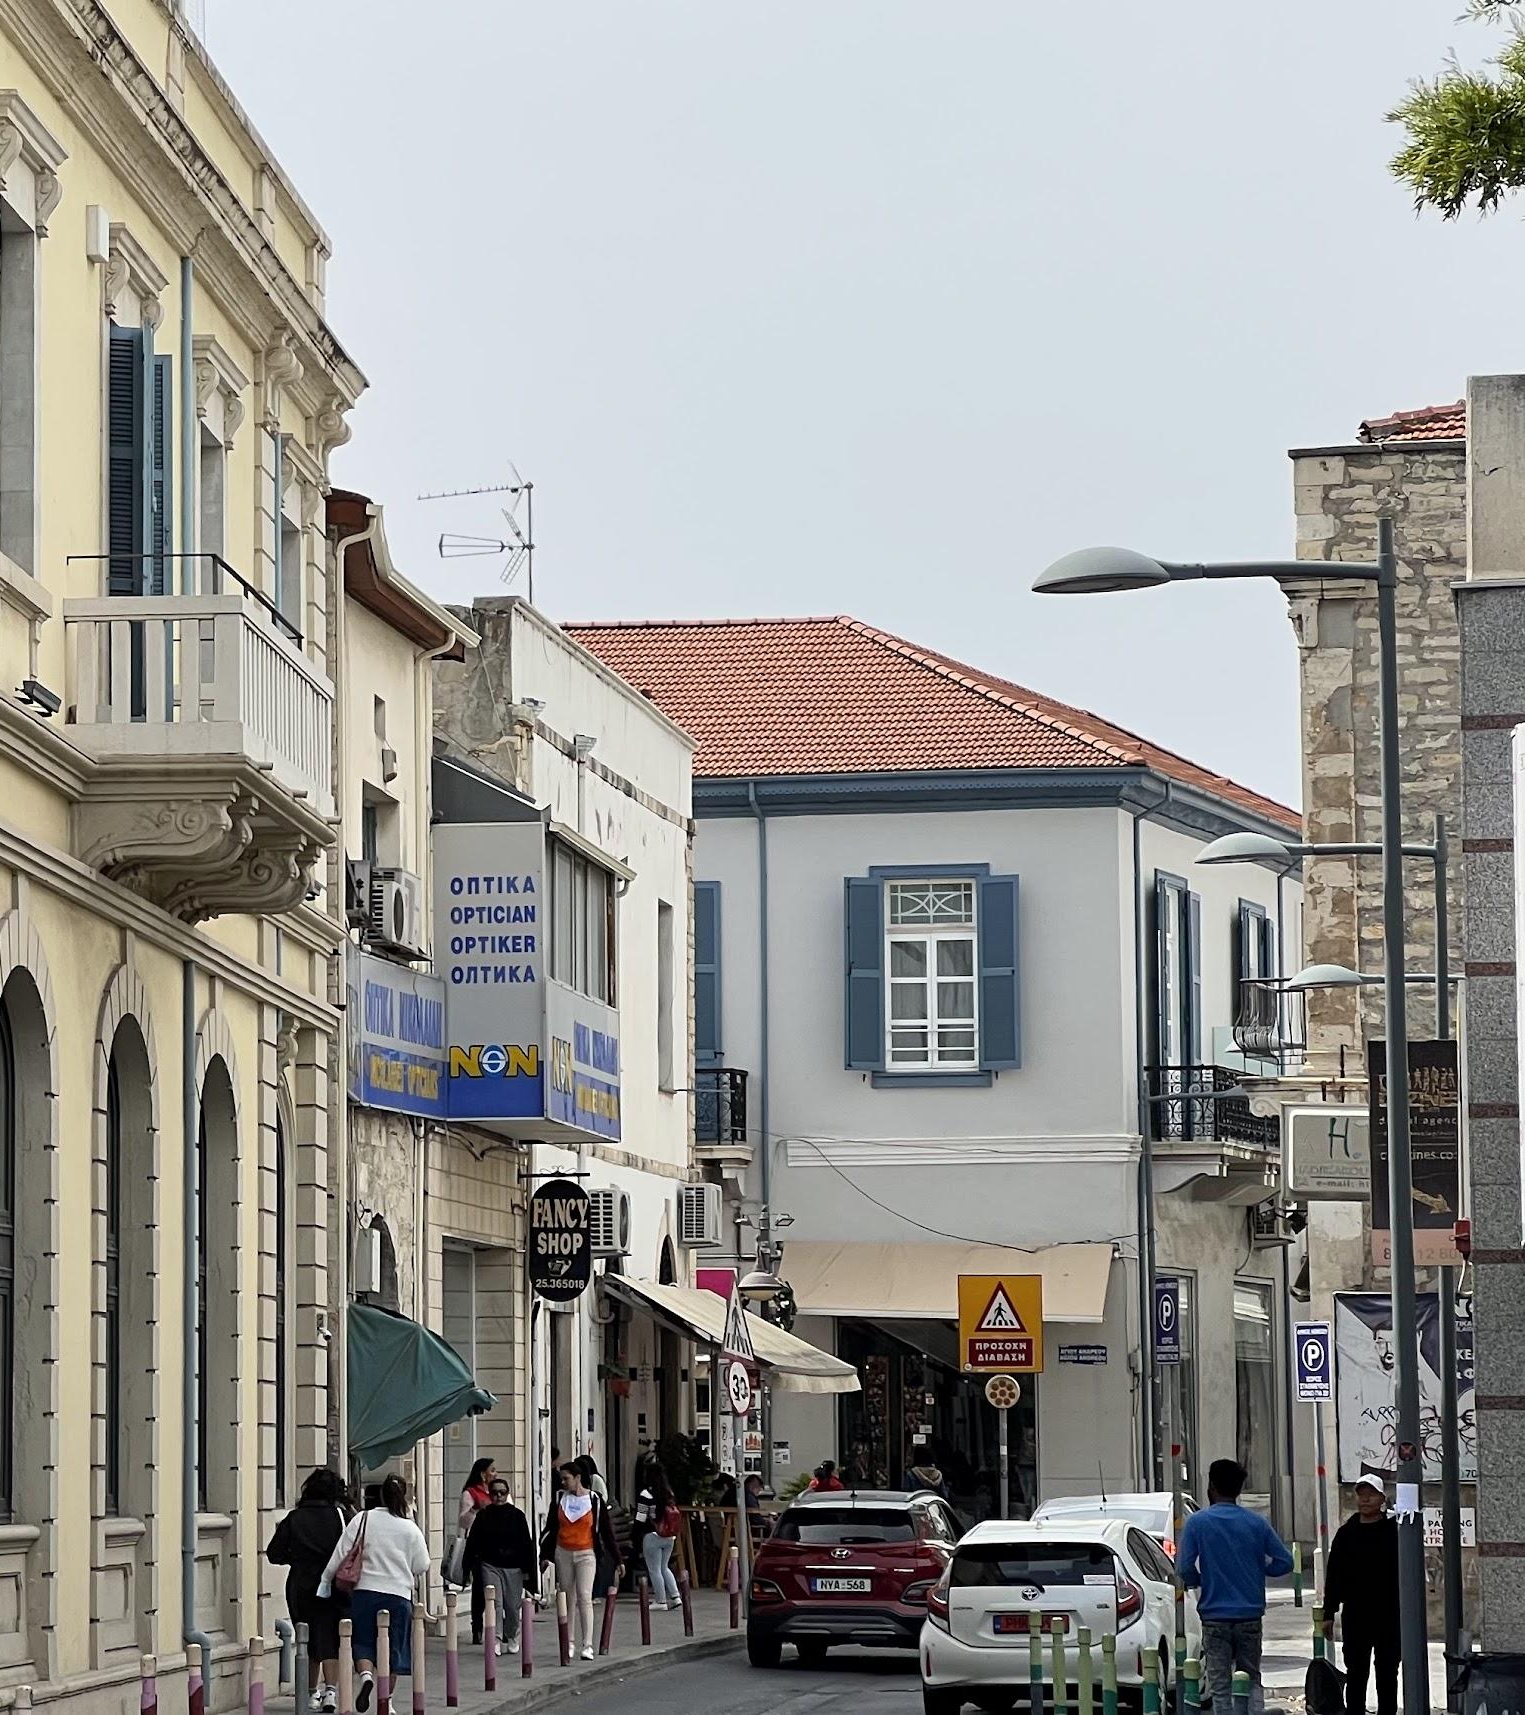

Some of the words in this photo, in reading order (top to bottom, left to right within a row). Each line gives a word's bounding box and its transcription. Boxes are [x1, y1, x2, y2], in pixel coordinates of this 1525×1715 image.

[450, 876, 535, 896] ΟΠΤΙΚΑ
[450, 905, 536, 925] OPTICIAN
[450, 935, 536, 955] OPTIKER
[532, 1198, 589, 1229] FANCY
[537, 1232, 583, 1255] SHOP
[1162, 1301, 1172, 1326] P
[975, 1342, 1027, 1350] ΠΡΟΣΟΧΗ
[1307, 1344, 1321, 1367] P
[977, 1353, 1026, 1362] ΔΙΑΒΑΣΗ
[732, 1374, 749, 1402] 30
